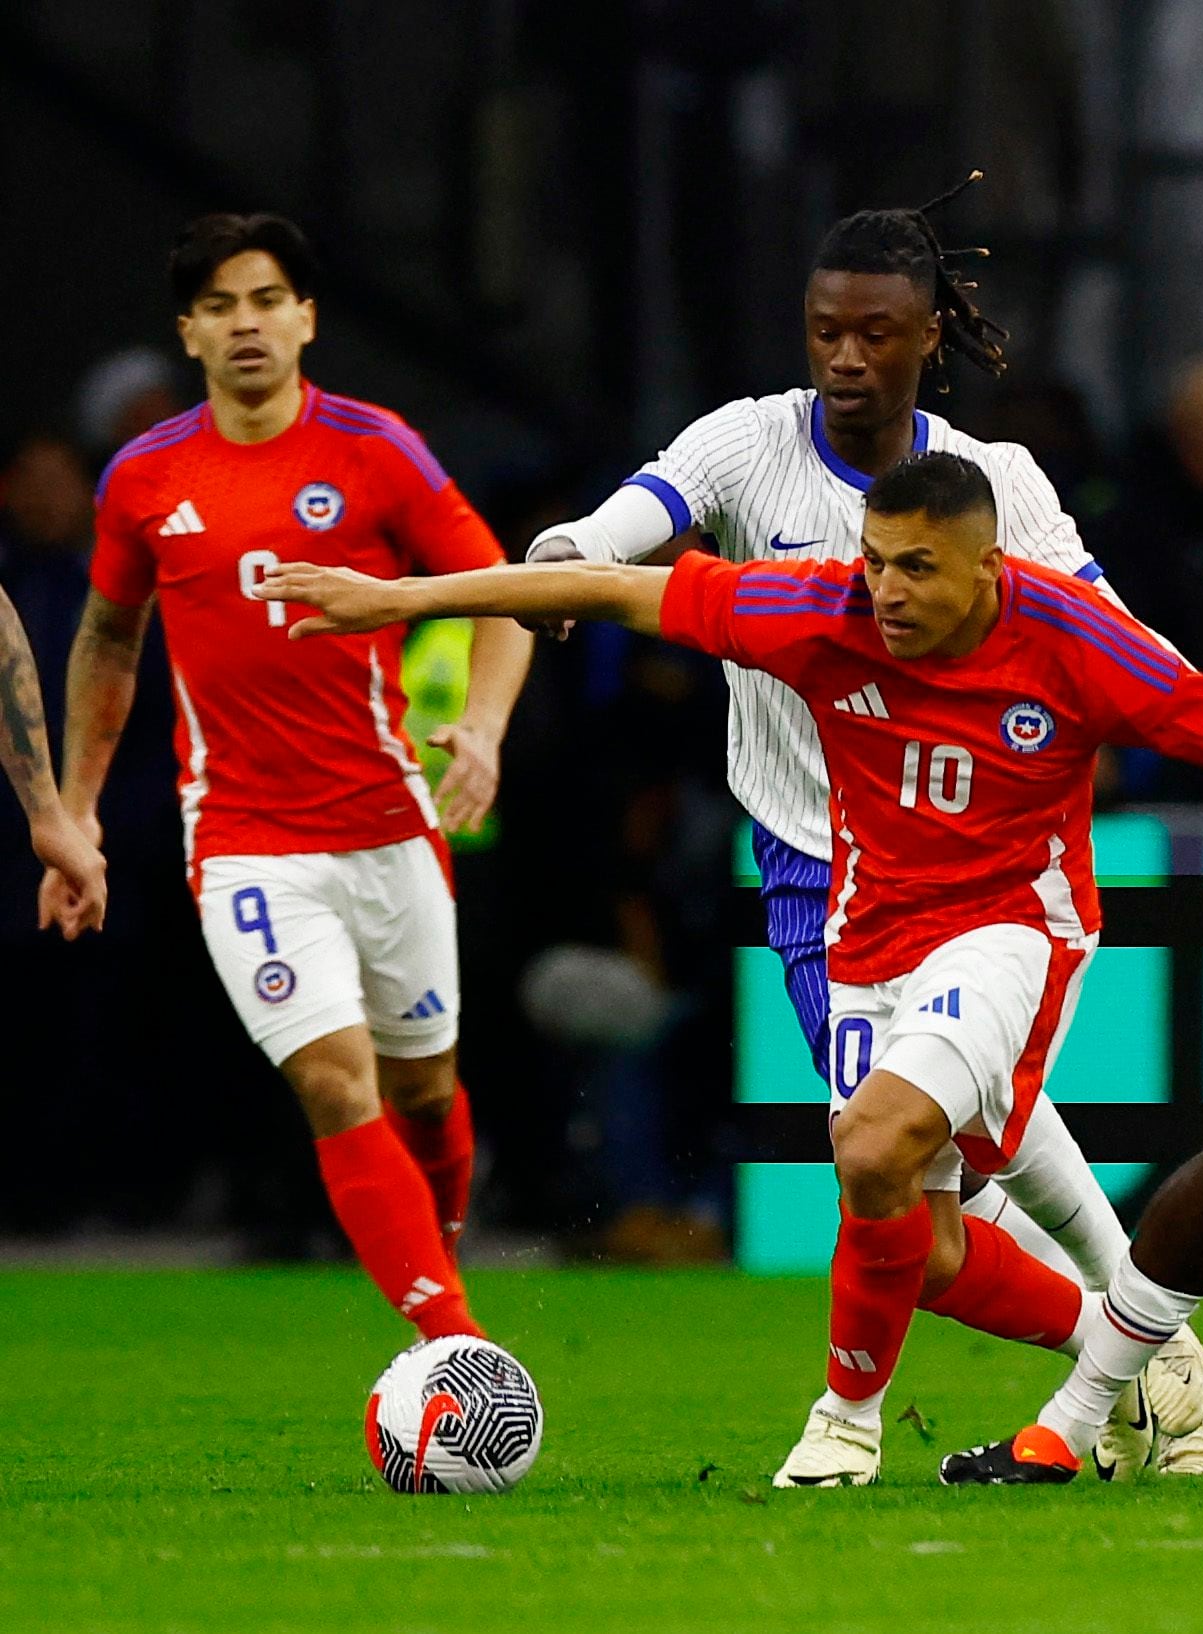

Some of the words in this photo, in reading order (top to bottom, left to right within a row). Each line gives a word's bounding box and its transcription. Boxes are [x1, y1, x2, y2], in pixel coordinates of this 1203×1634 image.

[239, 548, 286, 627] 9
[899, 740, 973, 814] 10
[232, 887, 277, 954] 9
